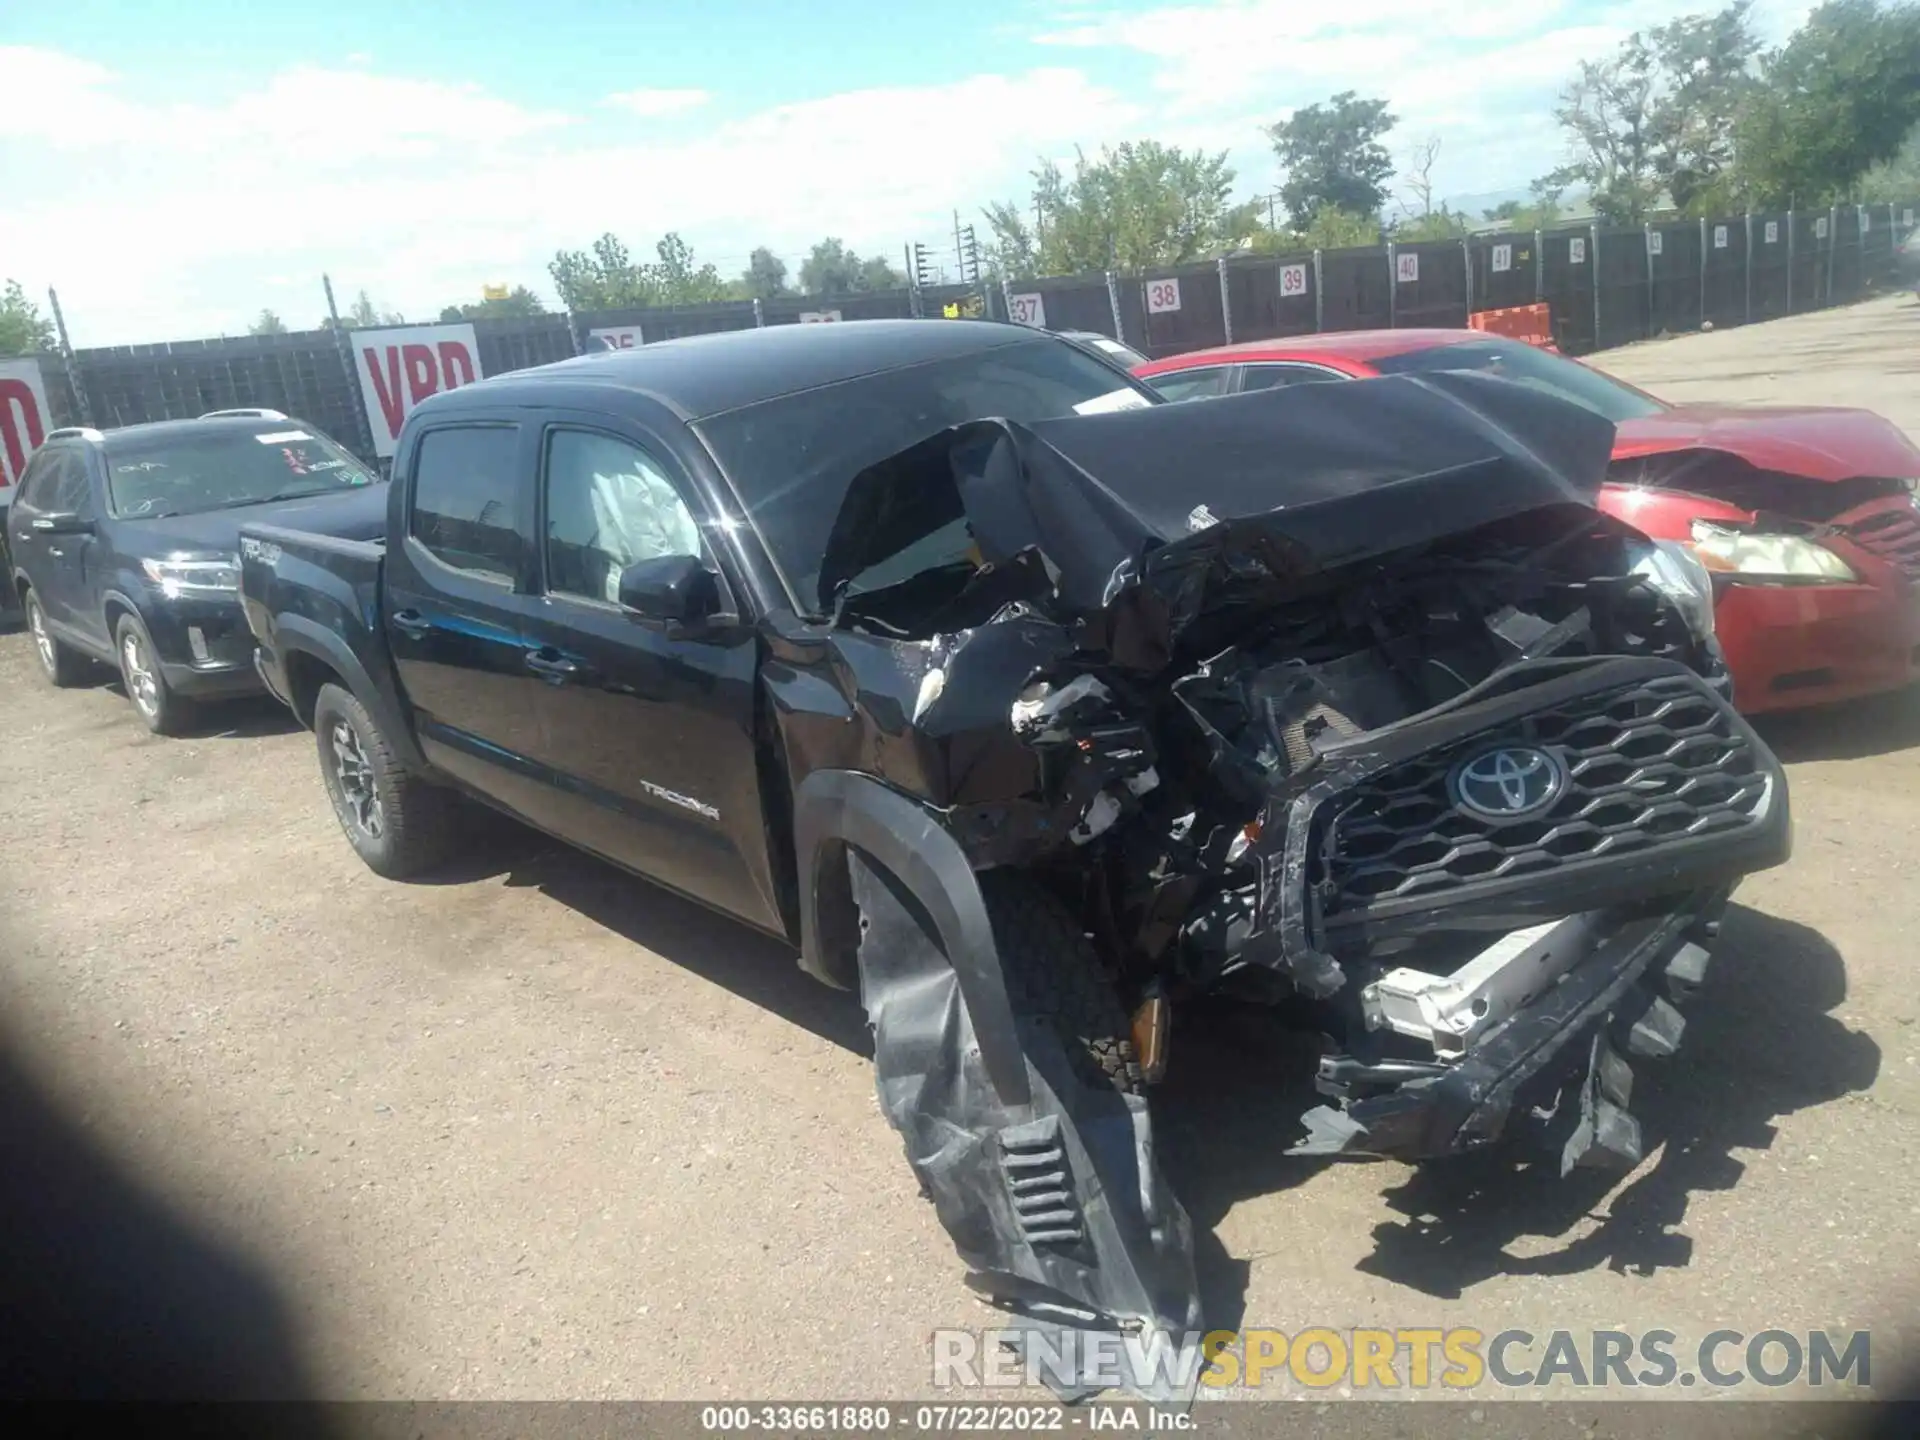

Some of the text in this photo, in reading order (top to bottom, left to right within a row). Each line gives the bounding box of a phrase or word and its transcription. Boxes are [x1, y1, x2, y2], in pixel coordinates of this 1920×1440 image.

[1401, 256, 1415, 277] 40
[1284, 269, 1302, 290] 39
[1152, 284, 1175, 307] 38
[1016, 300, 1037, 322] 37
